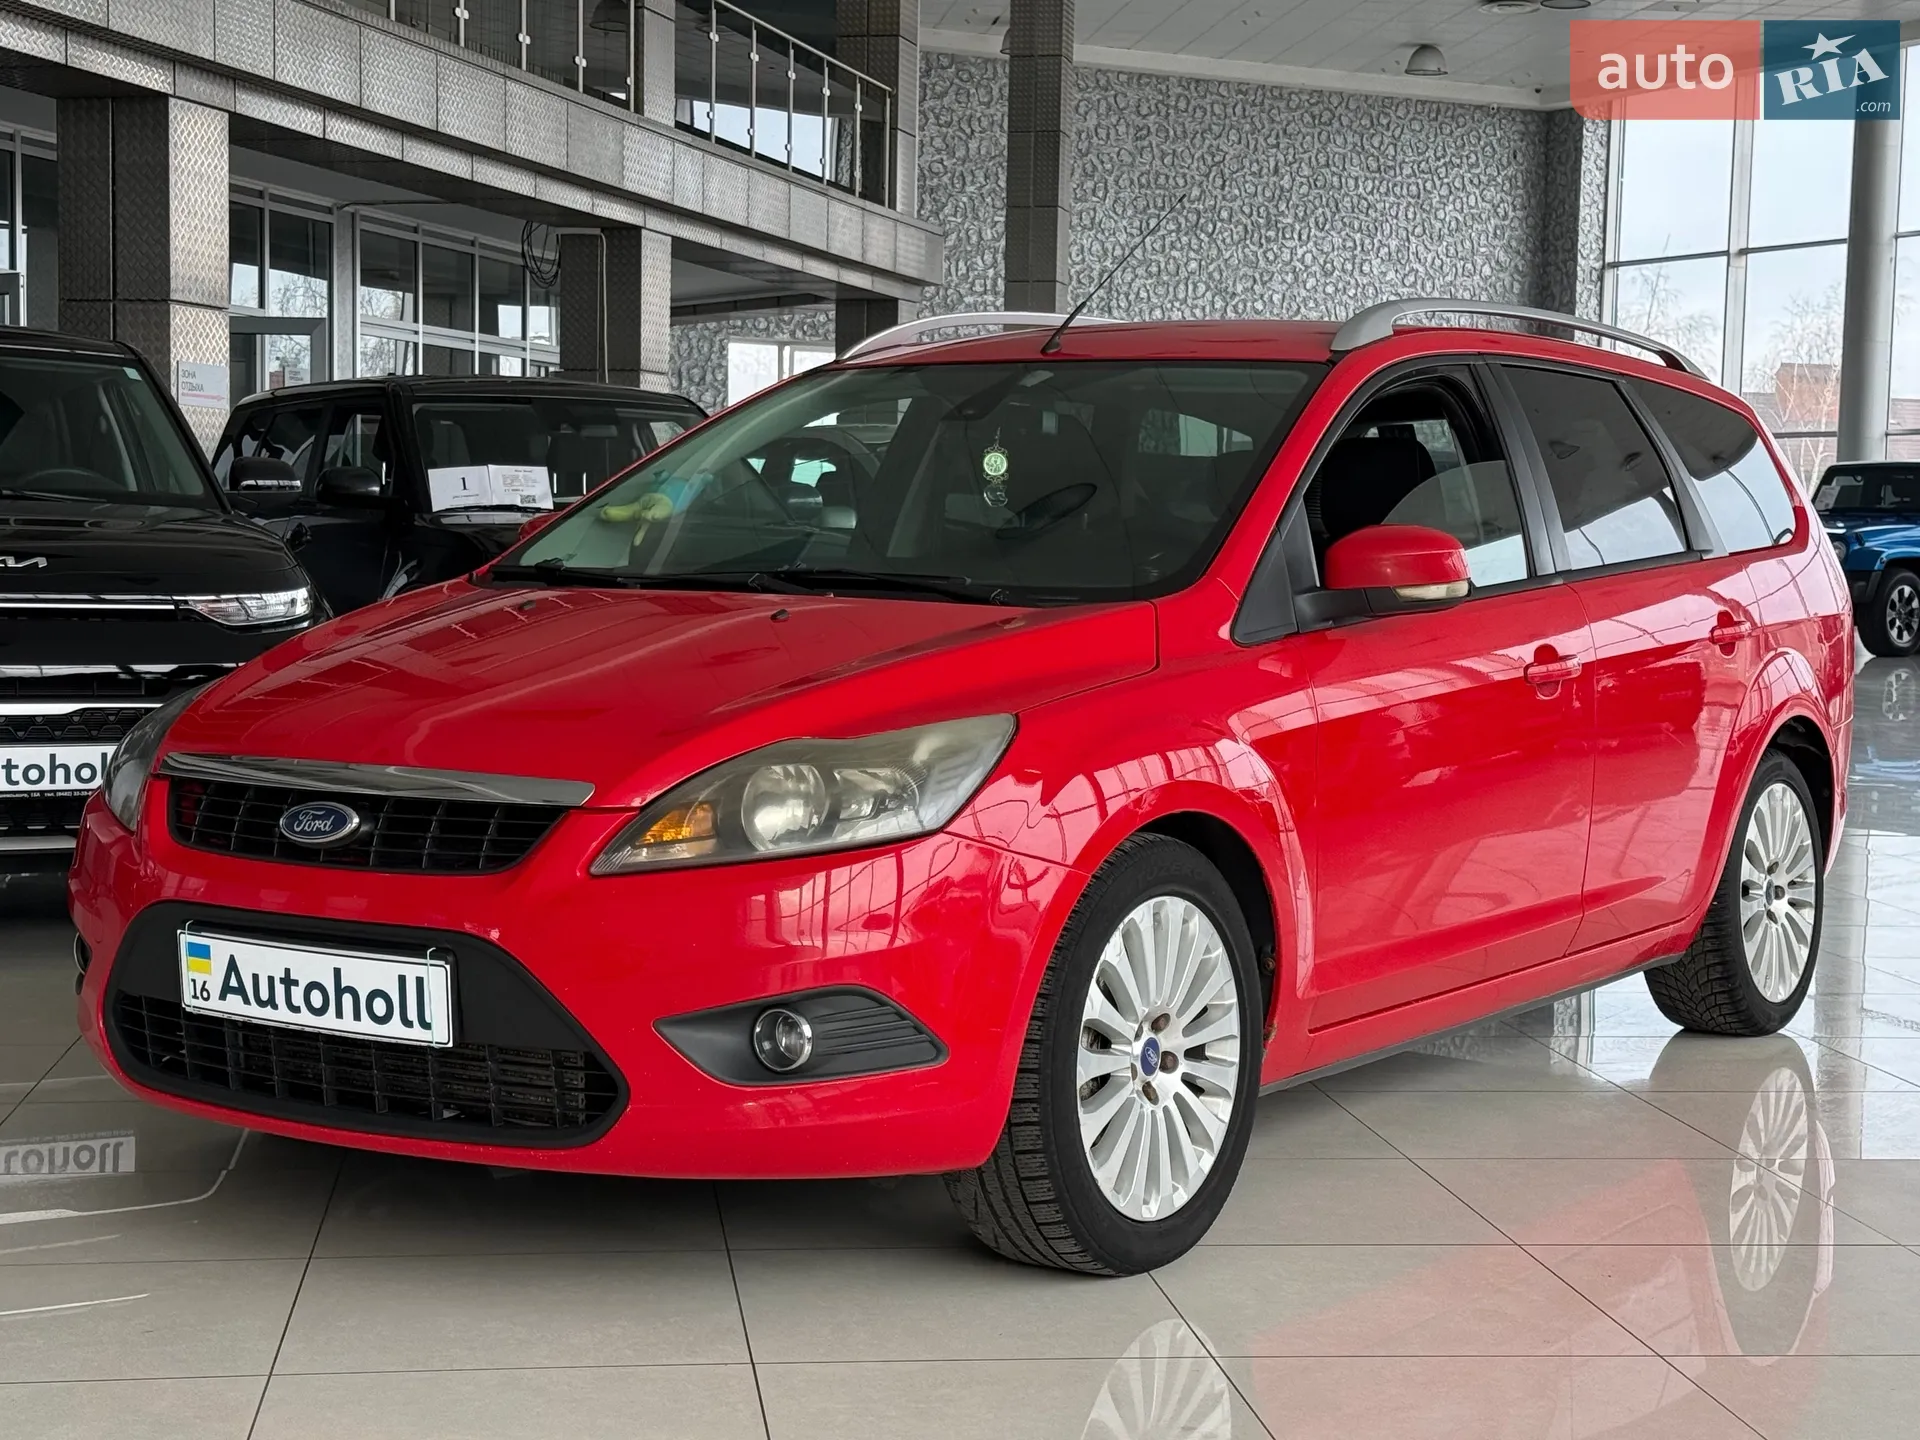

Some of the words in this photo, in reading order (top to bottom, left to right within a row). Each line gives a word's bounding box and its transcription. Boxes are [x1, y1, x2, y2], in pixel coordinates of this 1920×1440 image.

[181, 369, 197, 379] ЗОНА
[294, 809, 335, 832] Ford
[190, 978, 211, 1002] 16
[218, 954, 432, 1031] Autoholl
